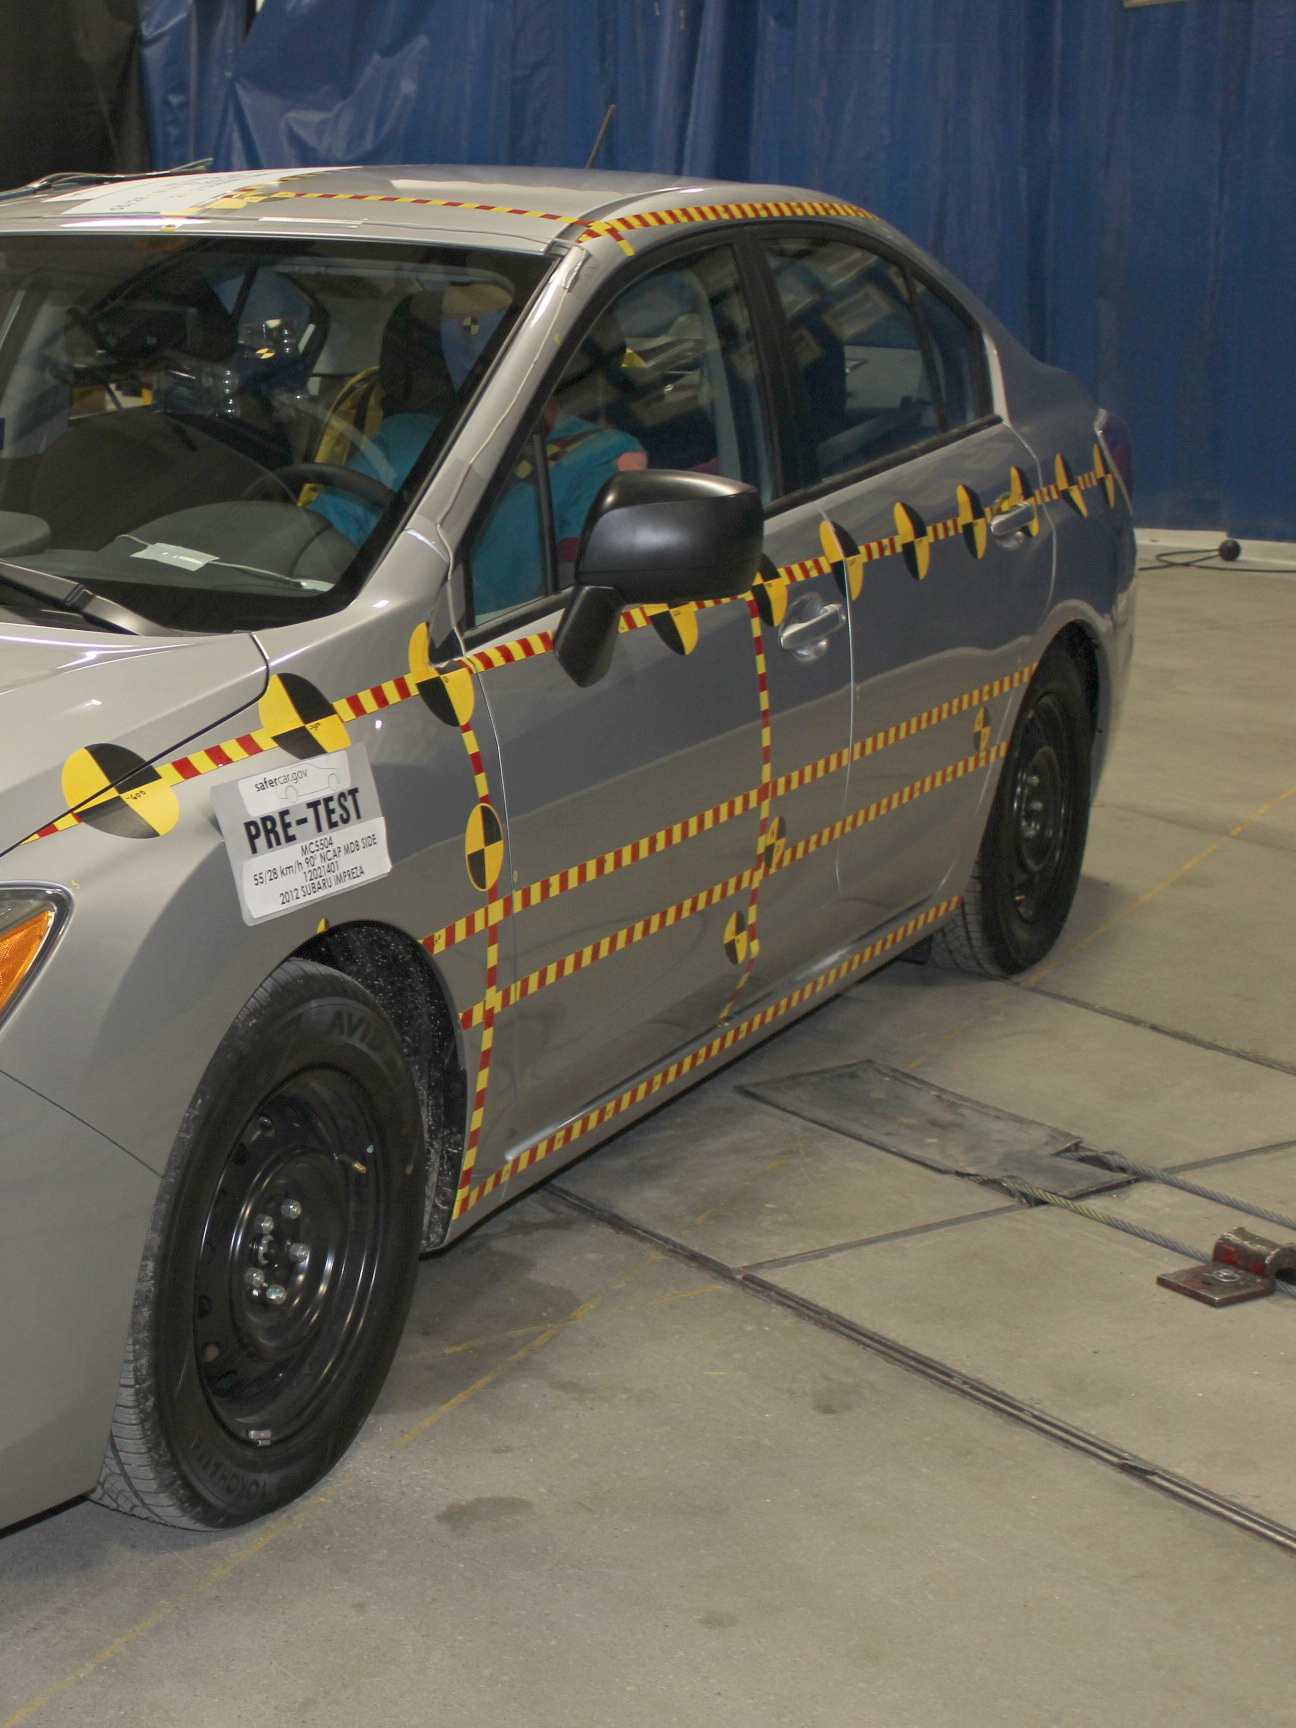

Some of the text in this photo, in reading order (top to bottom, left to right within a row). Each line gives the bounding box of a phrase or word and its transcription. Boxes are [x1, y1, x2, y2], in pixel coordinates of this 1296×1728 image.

[254, 767, 308, 792] safercar.gov
[243, 787, 362, 855] PRE-TEST
[253, 867, 278, 886] 55/28
[279, 860, 304, 877] km/h
[320, 849, 342, 865] NCAP
[343, 839, 360, 856] MDB
[361, 833, 379, 850] SIDE
[300, 836, 334, 857] MC5504
[279, 865, 366, 906] 2012 SUBARU IMPREZA
[303, 860, 340, 883] 12021401
